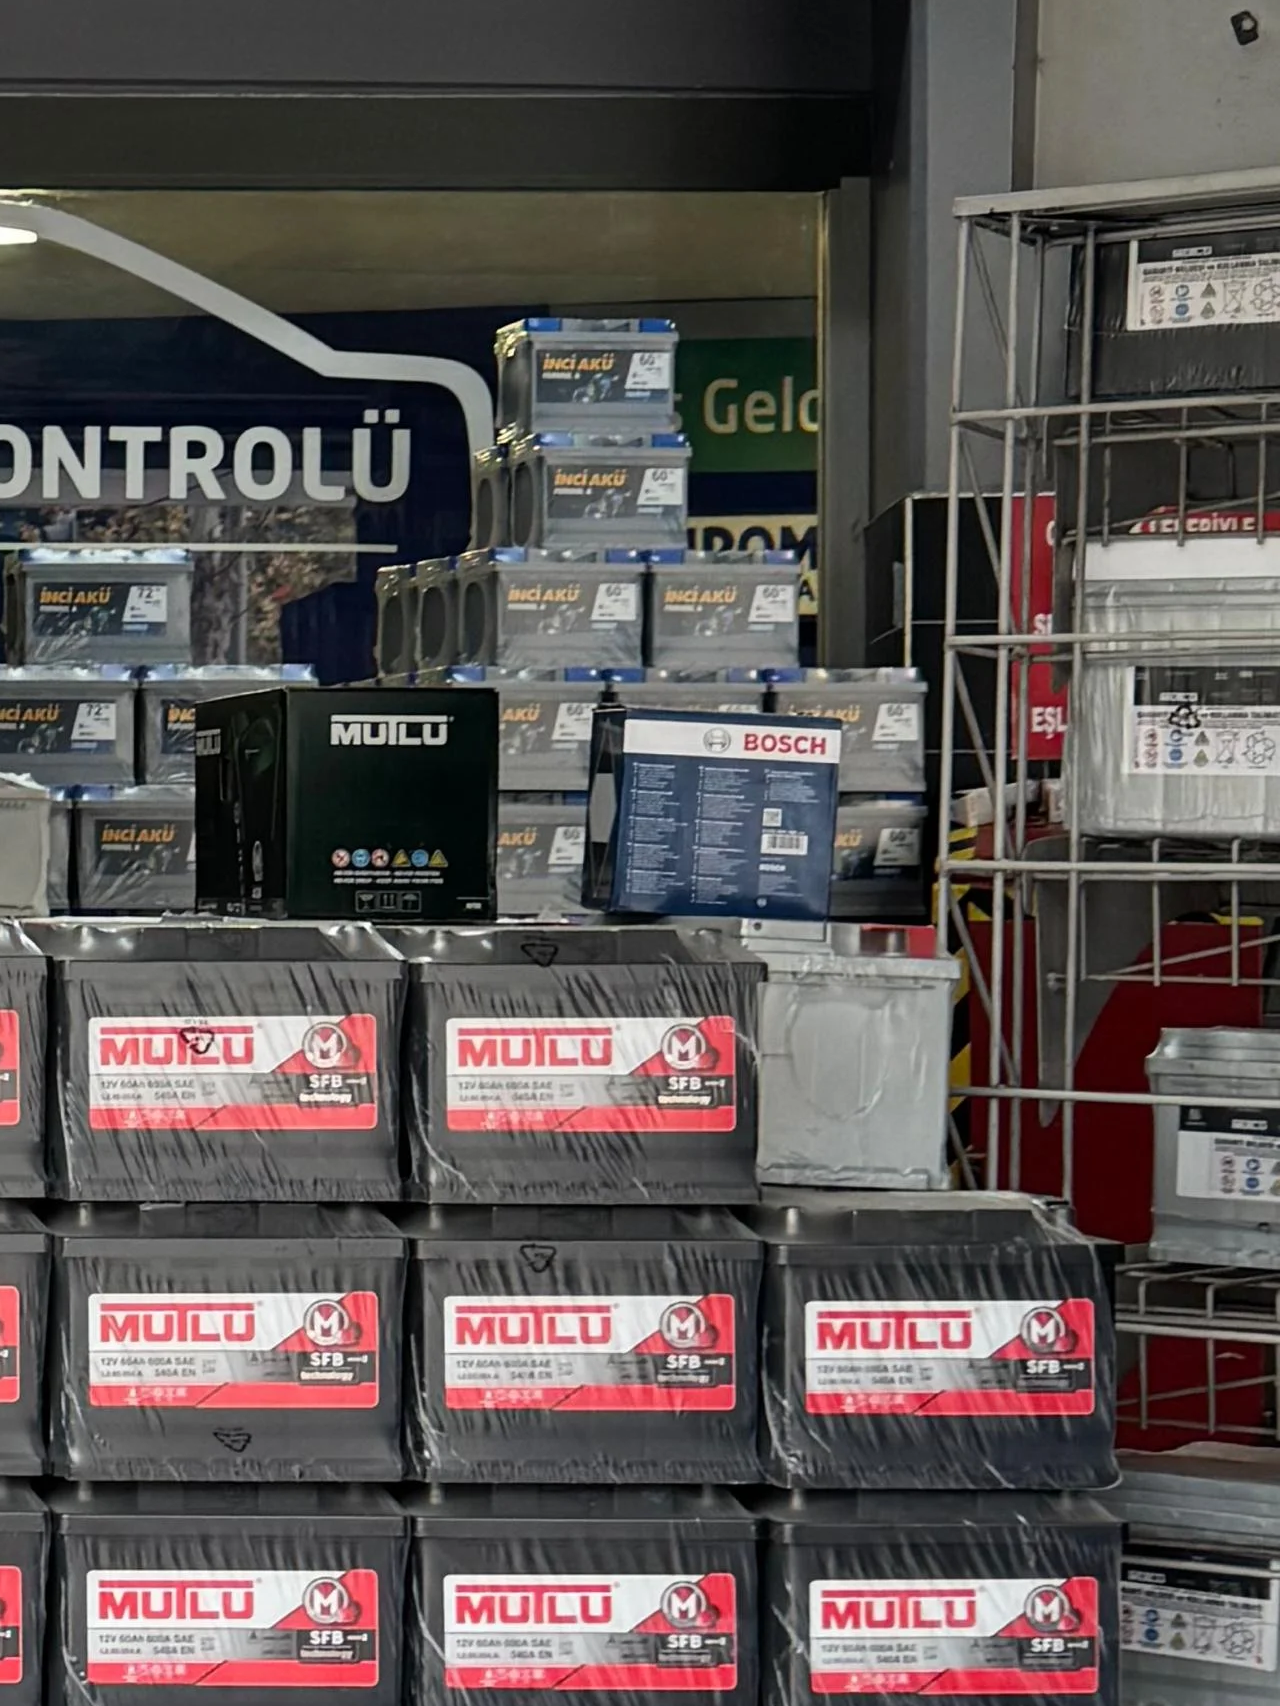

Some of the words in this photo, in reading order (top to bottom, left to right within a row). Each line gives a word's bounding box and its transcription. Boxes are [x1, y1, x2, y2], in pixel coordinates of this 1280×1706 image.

[577, 353, 614, 370] AKÜ
[589, 469, 627, 486] AKÜ
[73, 587, 112, 604] AKÜ
[21, 704, 61, 721] AKÜ
[330, 715, 448, 746] MUTLU
[743, 733, 827, 755] BOSCH
[100, 1026, 253, 1066] MUTLU
[458, 1027, 612, 1067] MUTLU
[309, 1075, 343, 1088] SFB
[668, 1077, 702, 1090] SFB
[100, 1303, 255, 1342] MUTLU
[456, 1305, 611, 1345] MUTLU
[817, 1310, 972, 1350] MUTLU
[310, 1353, 344, 1366] SFB
[666, 1355, 701, 1369] SFB
[1026, 1360, 1061, 1373] SFB
[99, 1580, 253, 1619] MUTLU
[455, 1585, 612, 1624] MUTLU
[821, 1589, 976, 1629] MUTLU
[309, 1631, 344, 1644] SFB
[667, 1635, 702, 1648] SFB
[1031, 1638, 1065, 1652] SFB
